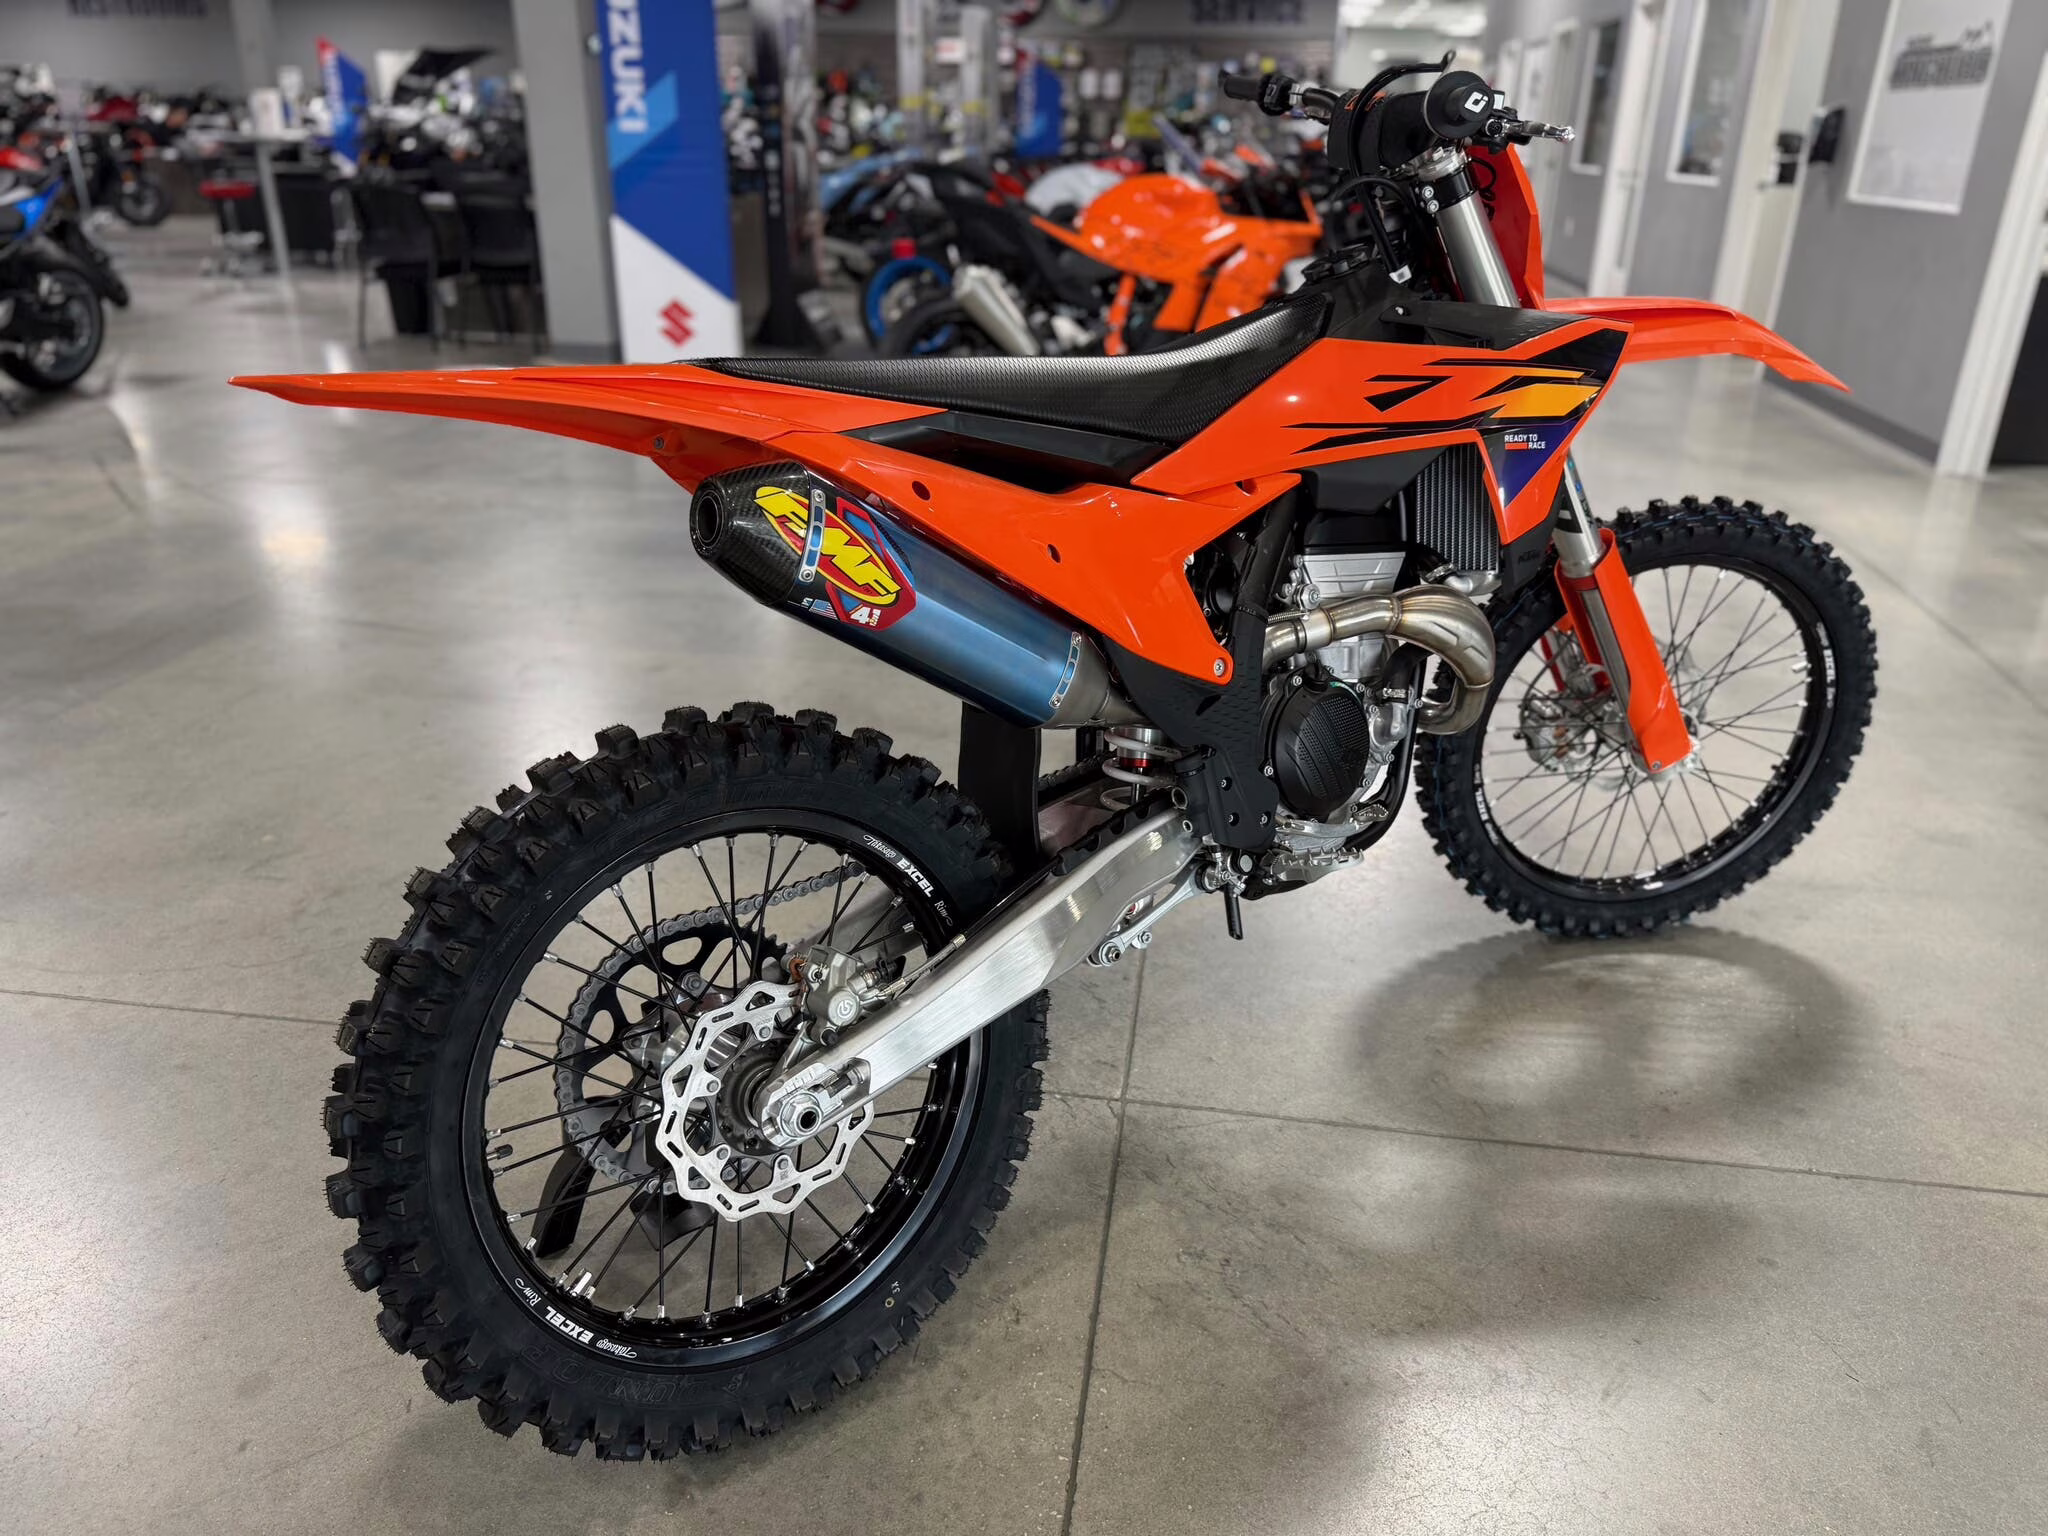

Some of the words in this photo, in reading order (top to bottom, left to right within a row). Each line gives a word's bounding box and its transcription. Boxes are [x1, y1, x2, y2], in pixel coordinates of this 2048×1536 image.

[1504, 434, 1528, 443] READY
[1529, 434, 1538, 442] TO
[1528, 441, 1546, 449] RACE
[896, 857, 935, 898] EXCEL
[544, 1305, 595, 1345] EXCEL
